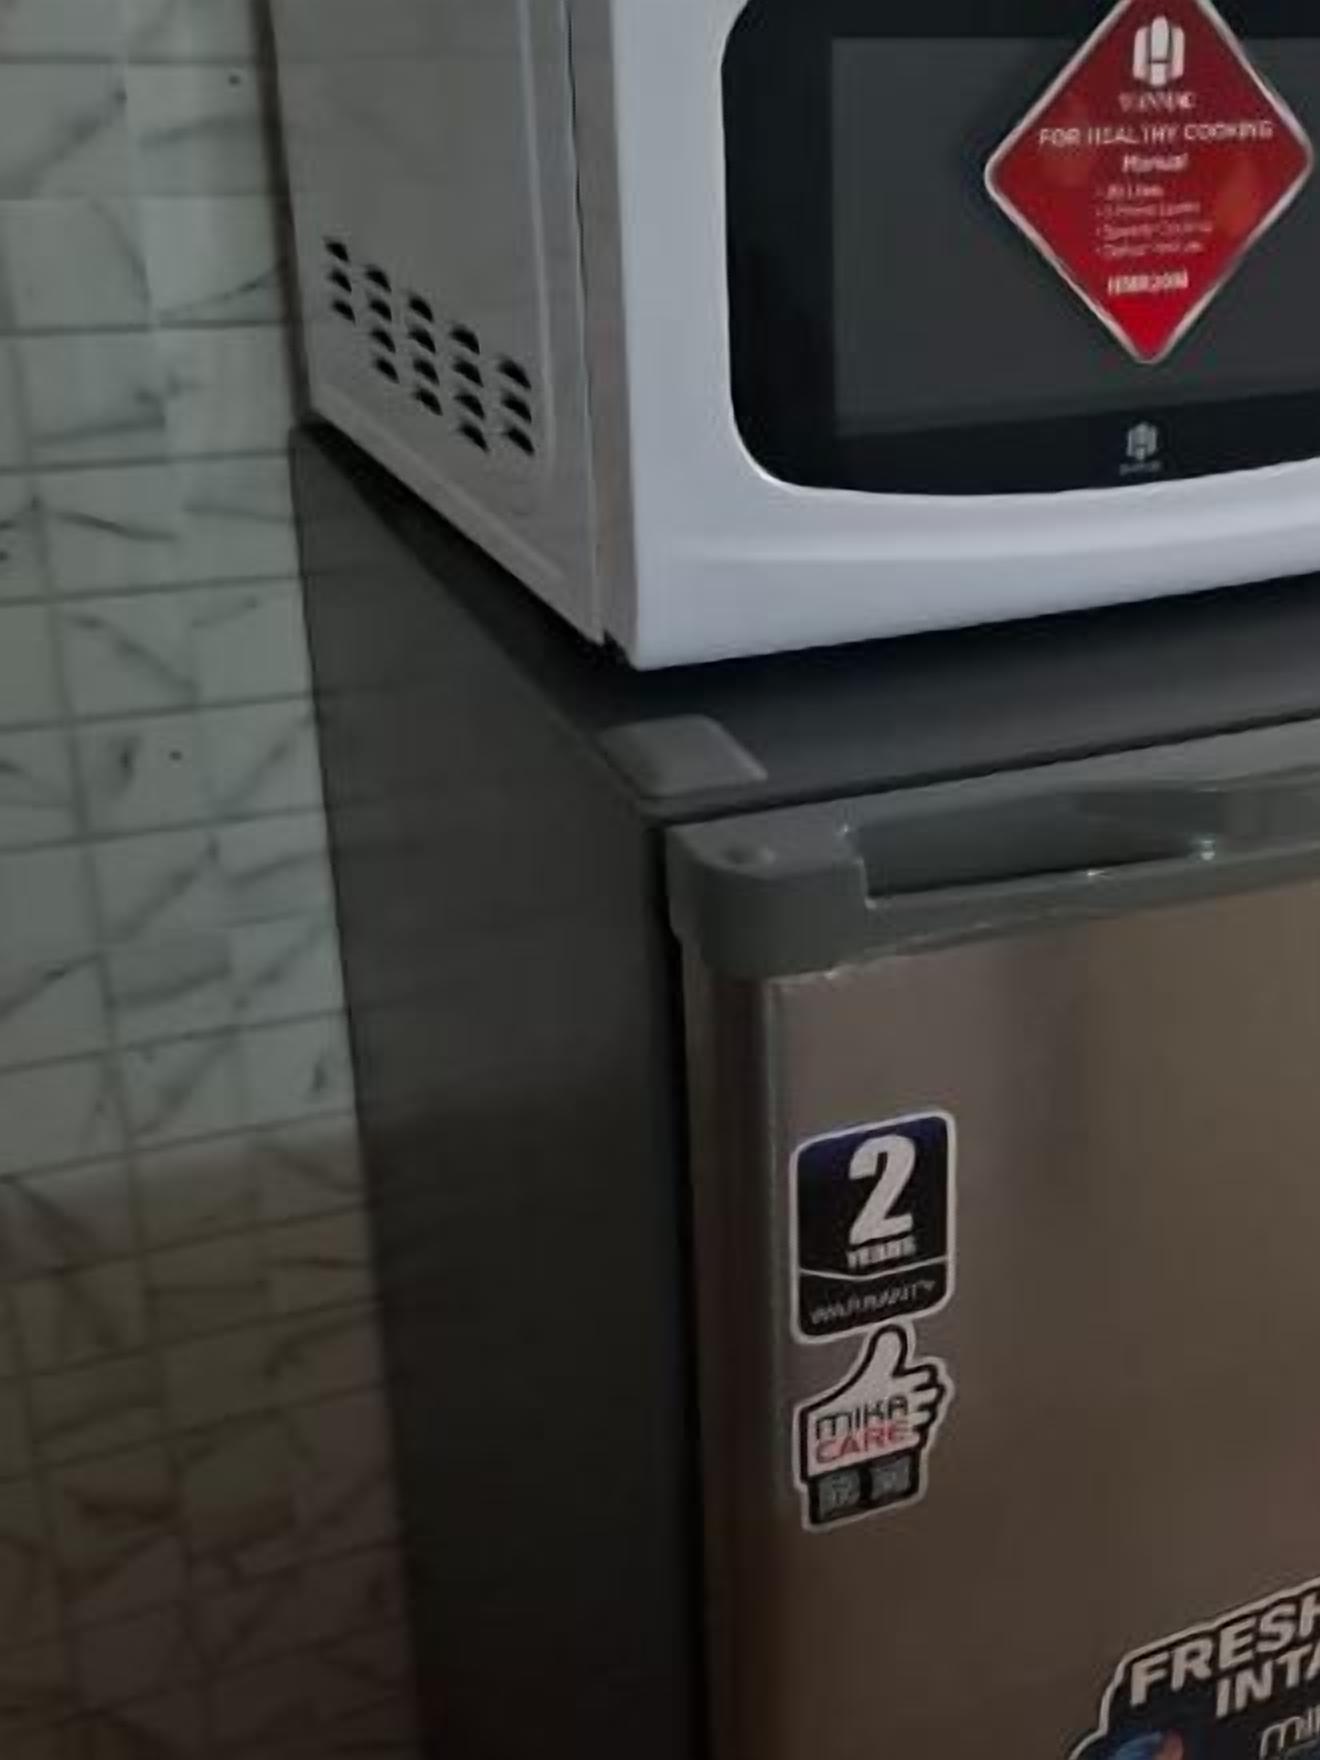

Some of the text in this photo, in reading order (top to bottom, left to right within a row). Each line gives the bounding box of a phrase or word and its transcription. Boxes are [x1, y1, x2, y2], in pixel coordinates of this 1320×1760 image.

[1039, 126, 1081, 147] FOR
[1183, 120, 1274, 142] COOKING
[848, 1134, 916, 1246] 2
[815, 1424, 907, 1464] CARE
